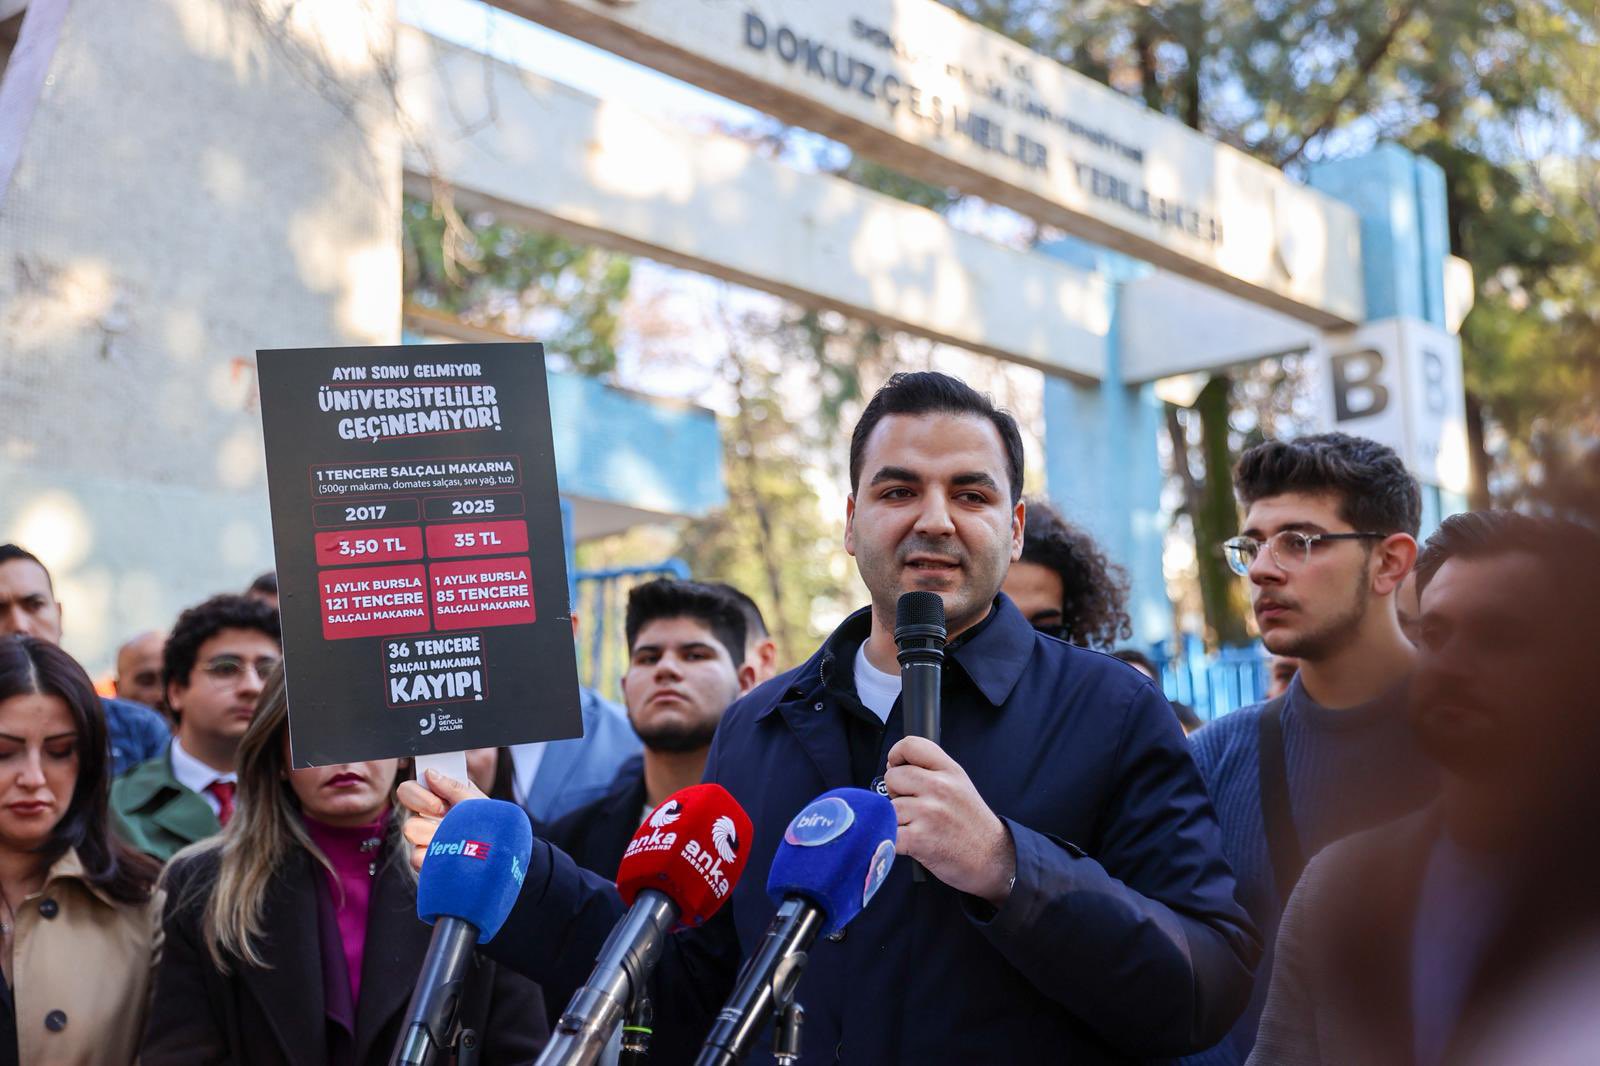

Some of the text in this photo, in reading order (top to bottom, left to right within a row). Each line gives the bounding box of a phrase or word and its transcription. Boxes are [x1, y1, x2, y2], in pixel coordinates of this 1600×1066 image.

[332, 363, 482, 381] AYIN SONU GELMİYOR
[1332, 348, 1389, 422] B
[318, 386, 498, 412] ÜNİVERSİTELİLER
[338, 406, 502, 444] GEÇİNEMİYOR!
[316, 461, 514, 481] 1 TENCERE SALÇALI MAKARNA
[318, 474, 515, 495] (500gr makarna, domates salçası, sıvı yağ, tuz)
[345, 506, 386, 521] 2017
[452, 499, 495, 515] 2025
[339, 538, 406, 557] 3,50 TL
[454, 531, 502, 547] 35 TL
[325, 577, 422, 593] 1 AYLIK BURSLA
[435, 570, 527, 586] 1 AYLIK BURSLA
[326, 592, 424, 611] 121 TENCERE
[436, 584, 529, 603] 85 TENCERE
[328, 608, 424, 624] SALÇALI MAKARNA
[437, 599, 530, 615] SALÇALI MAKARNA
[388, 636, 481, 659] 36 TENCERE
[389, 656, 482, 674] SALÇALI MAKARNA
[390, 670, 483, 703] KAYIP!
[625, 828, 677, 852] anka
[685, 839, 729, 897] anka
